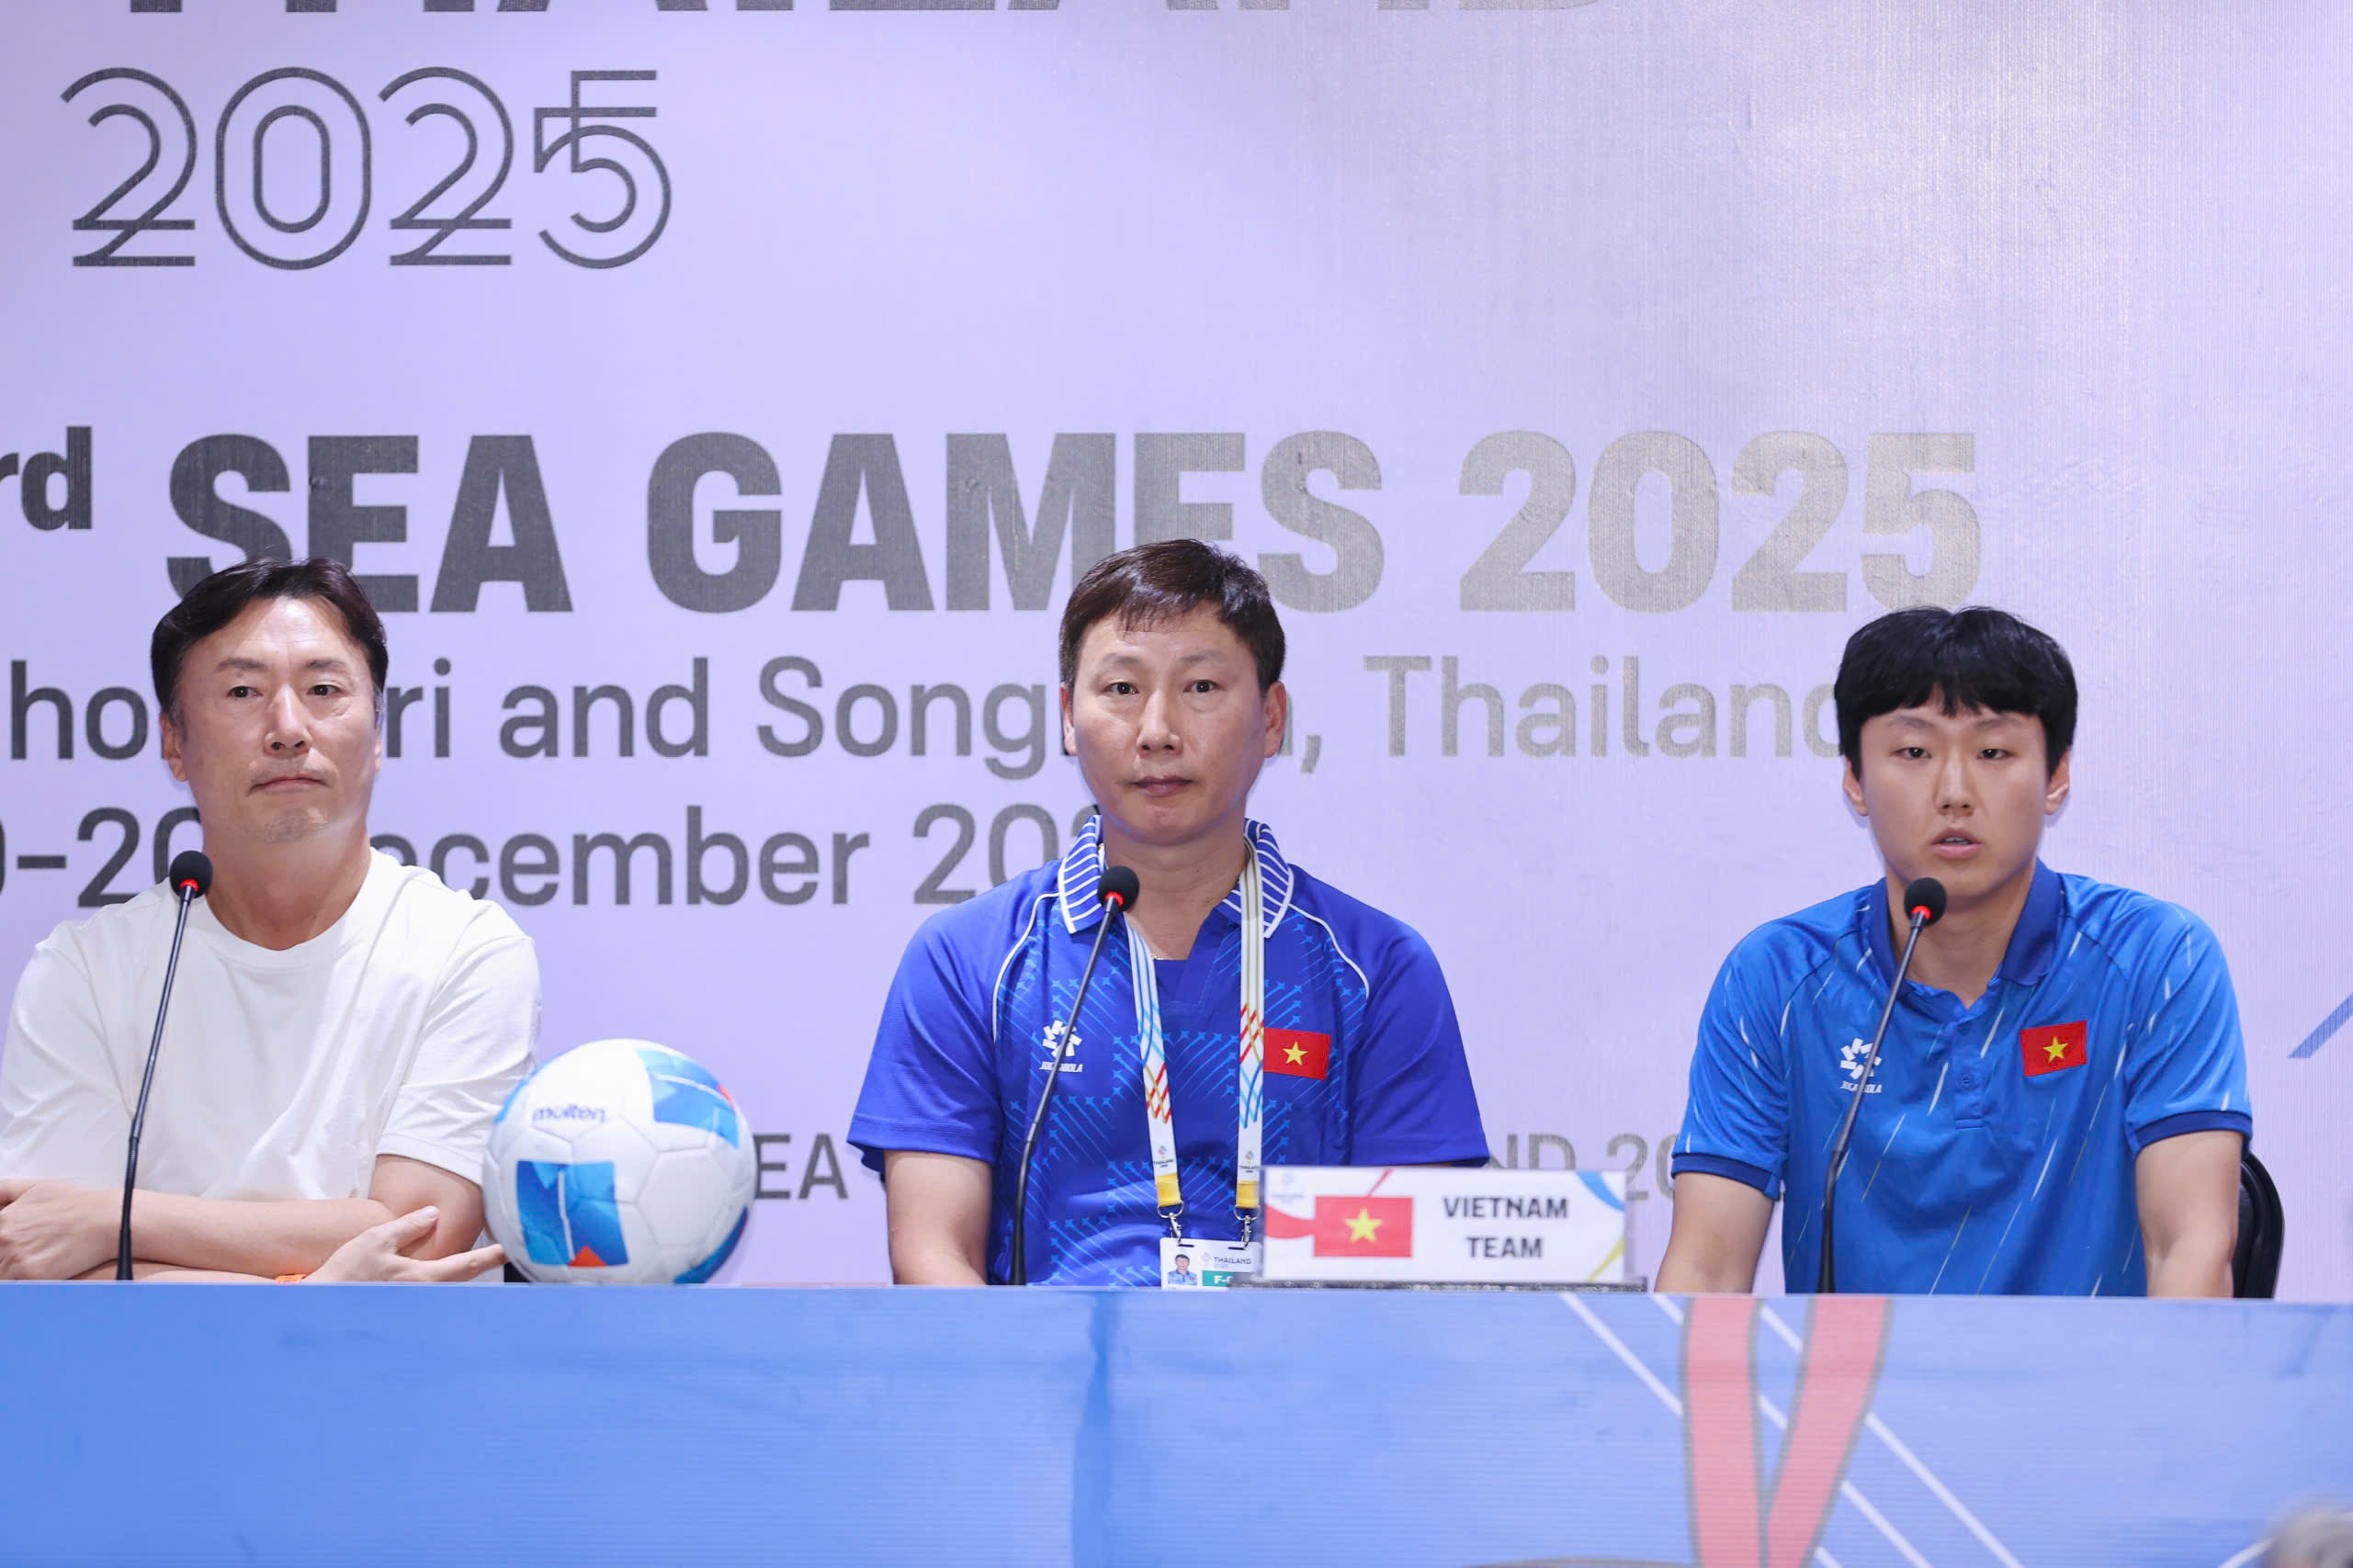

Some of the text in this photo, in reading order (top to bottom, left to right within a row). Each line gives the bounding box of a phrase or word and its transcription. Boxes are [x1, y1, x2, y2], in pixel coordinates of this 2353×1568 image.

[61, 66, 672, 270] 2025
[166, 433, 573, 613] SEA
[647, 430, 1386, 615] GAMES
[1459, 430, 1982, 615] 2025
[500, 657, 708, 759] and
[532, 1103, 606, 1123] molten
[752, 1133, 850, 1201] EA
[1443, 1196, 1569, 1220] VIETNAM
[1213, 1256, 1252, 1265] THAILAND
[1466, 1236, 1544, 1259] TEAM
